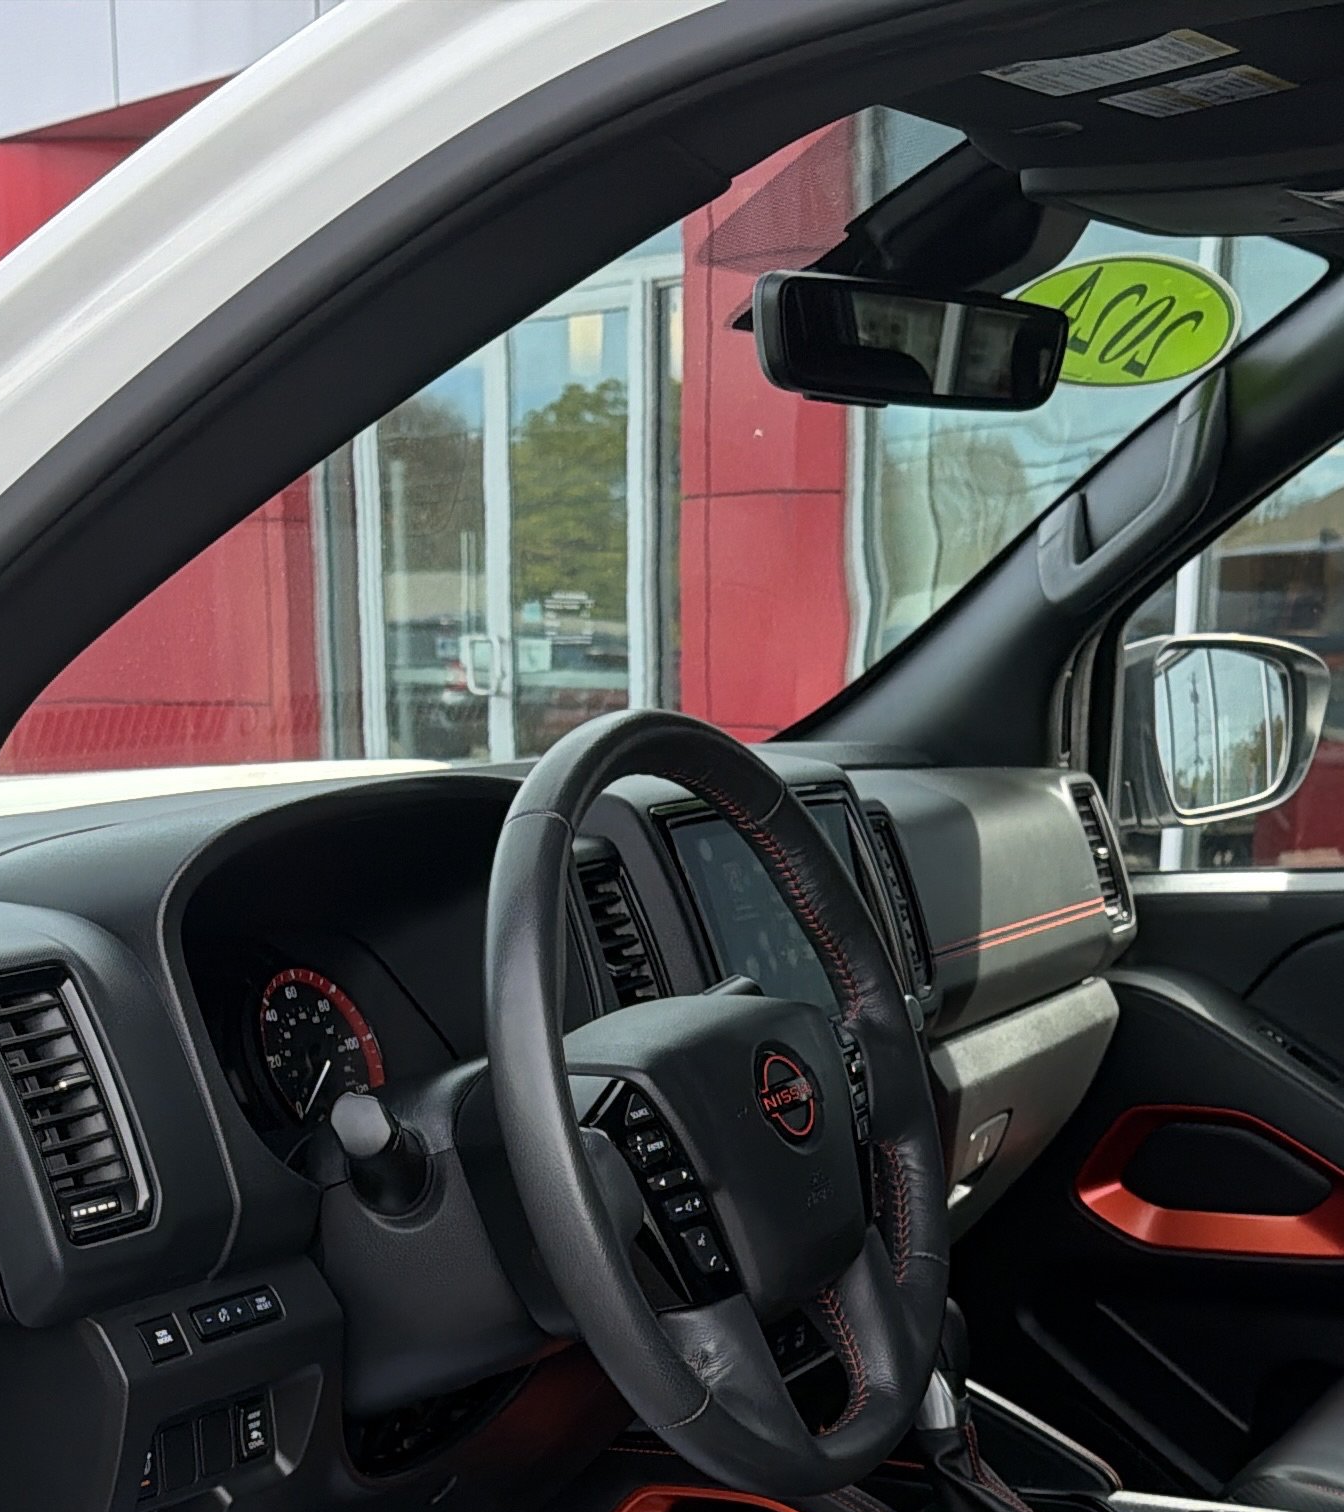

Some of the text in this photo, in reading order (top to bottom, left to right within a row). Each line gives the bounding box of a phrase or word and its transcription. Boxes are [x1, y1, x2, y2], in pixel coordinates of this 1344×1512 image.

[285, 986, 297, 999] 60
[318, 1000, 330, 1012] 80
[265, 1008, 278, 1022] 40
[267, 1055, 281, 1068] 20
